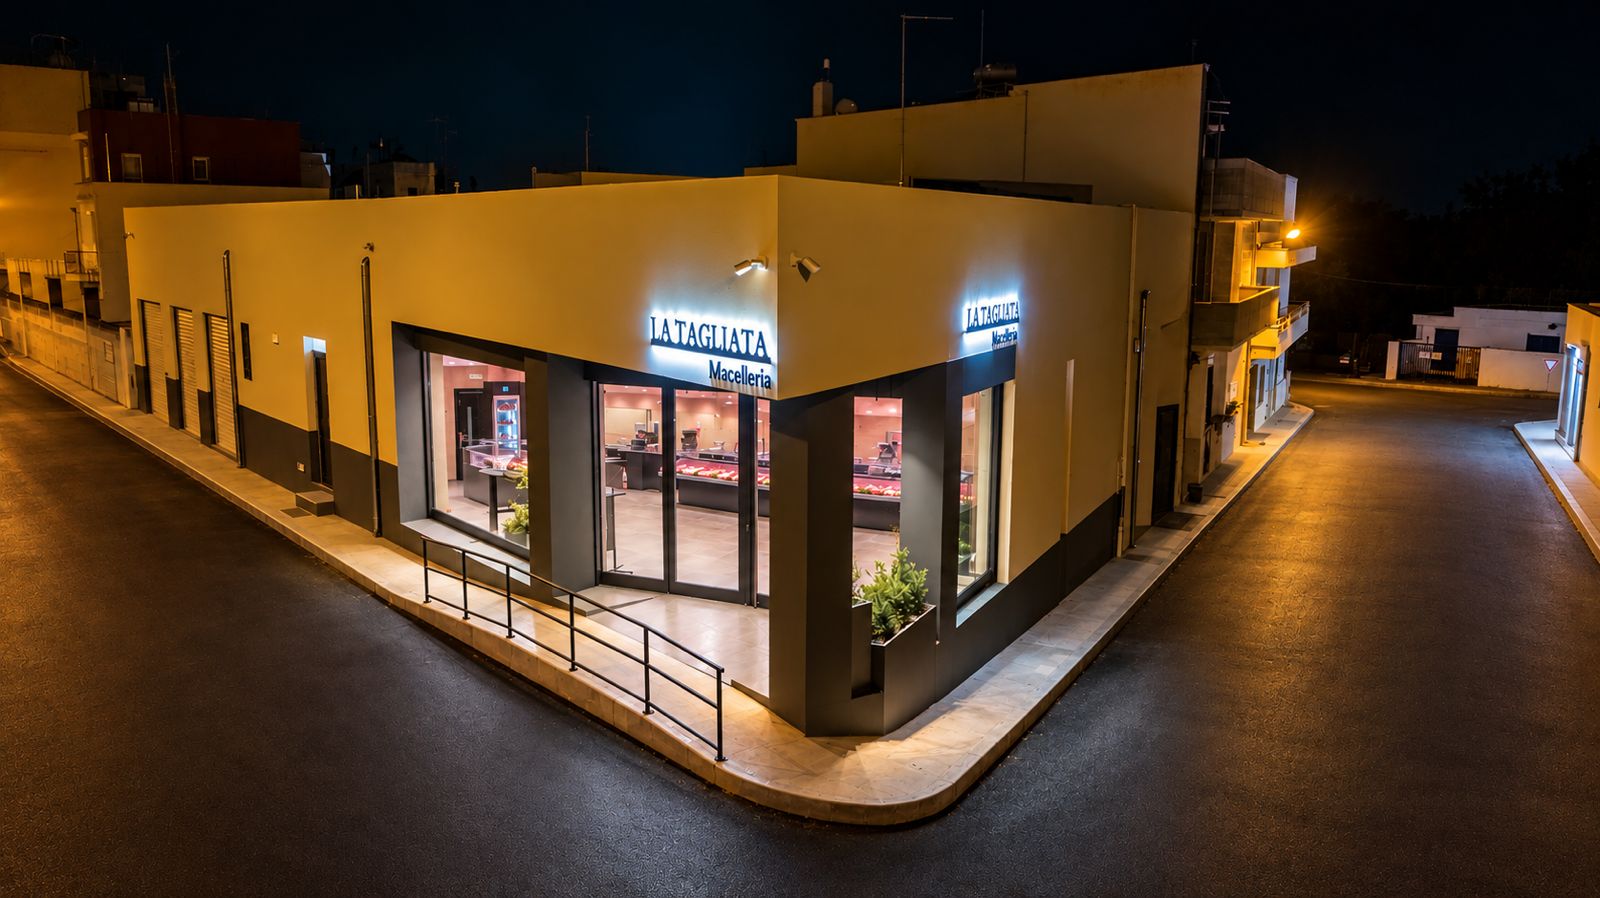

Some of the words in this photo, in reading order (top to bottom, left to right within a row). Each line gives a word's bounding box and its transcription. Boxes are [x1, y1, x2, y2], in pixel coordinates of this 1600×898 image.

[967, 307, 979, 328] LA
[981, 301, 1019, 325] TAGLIATA
[650, 316, 673, 342] LA
[674, 319, 771, 359] TAGLIATA
[708, 359, 772, 389] Macelleria
